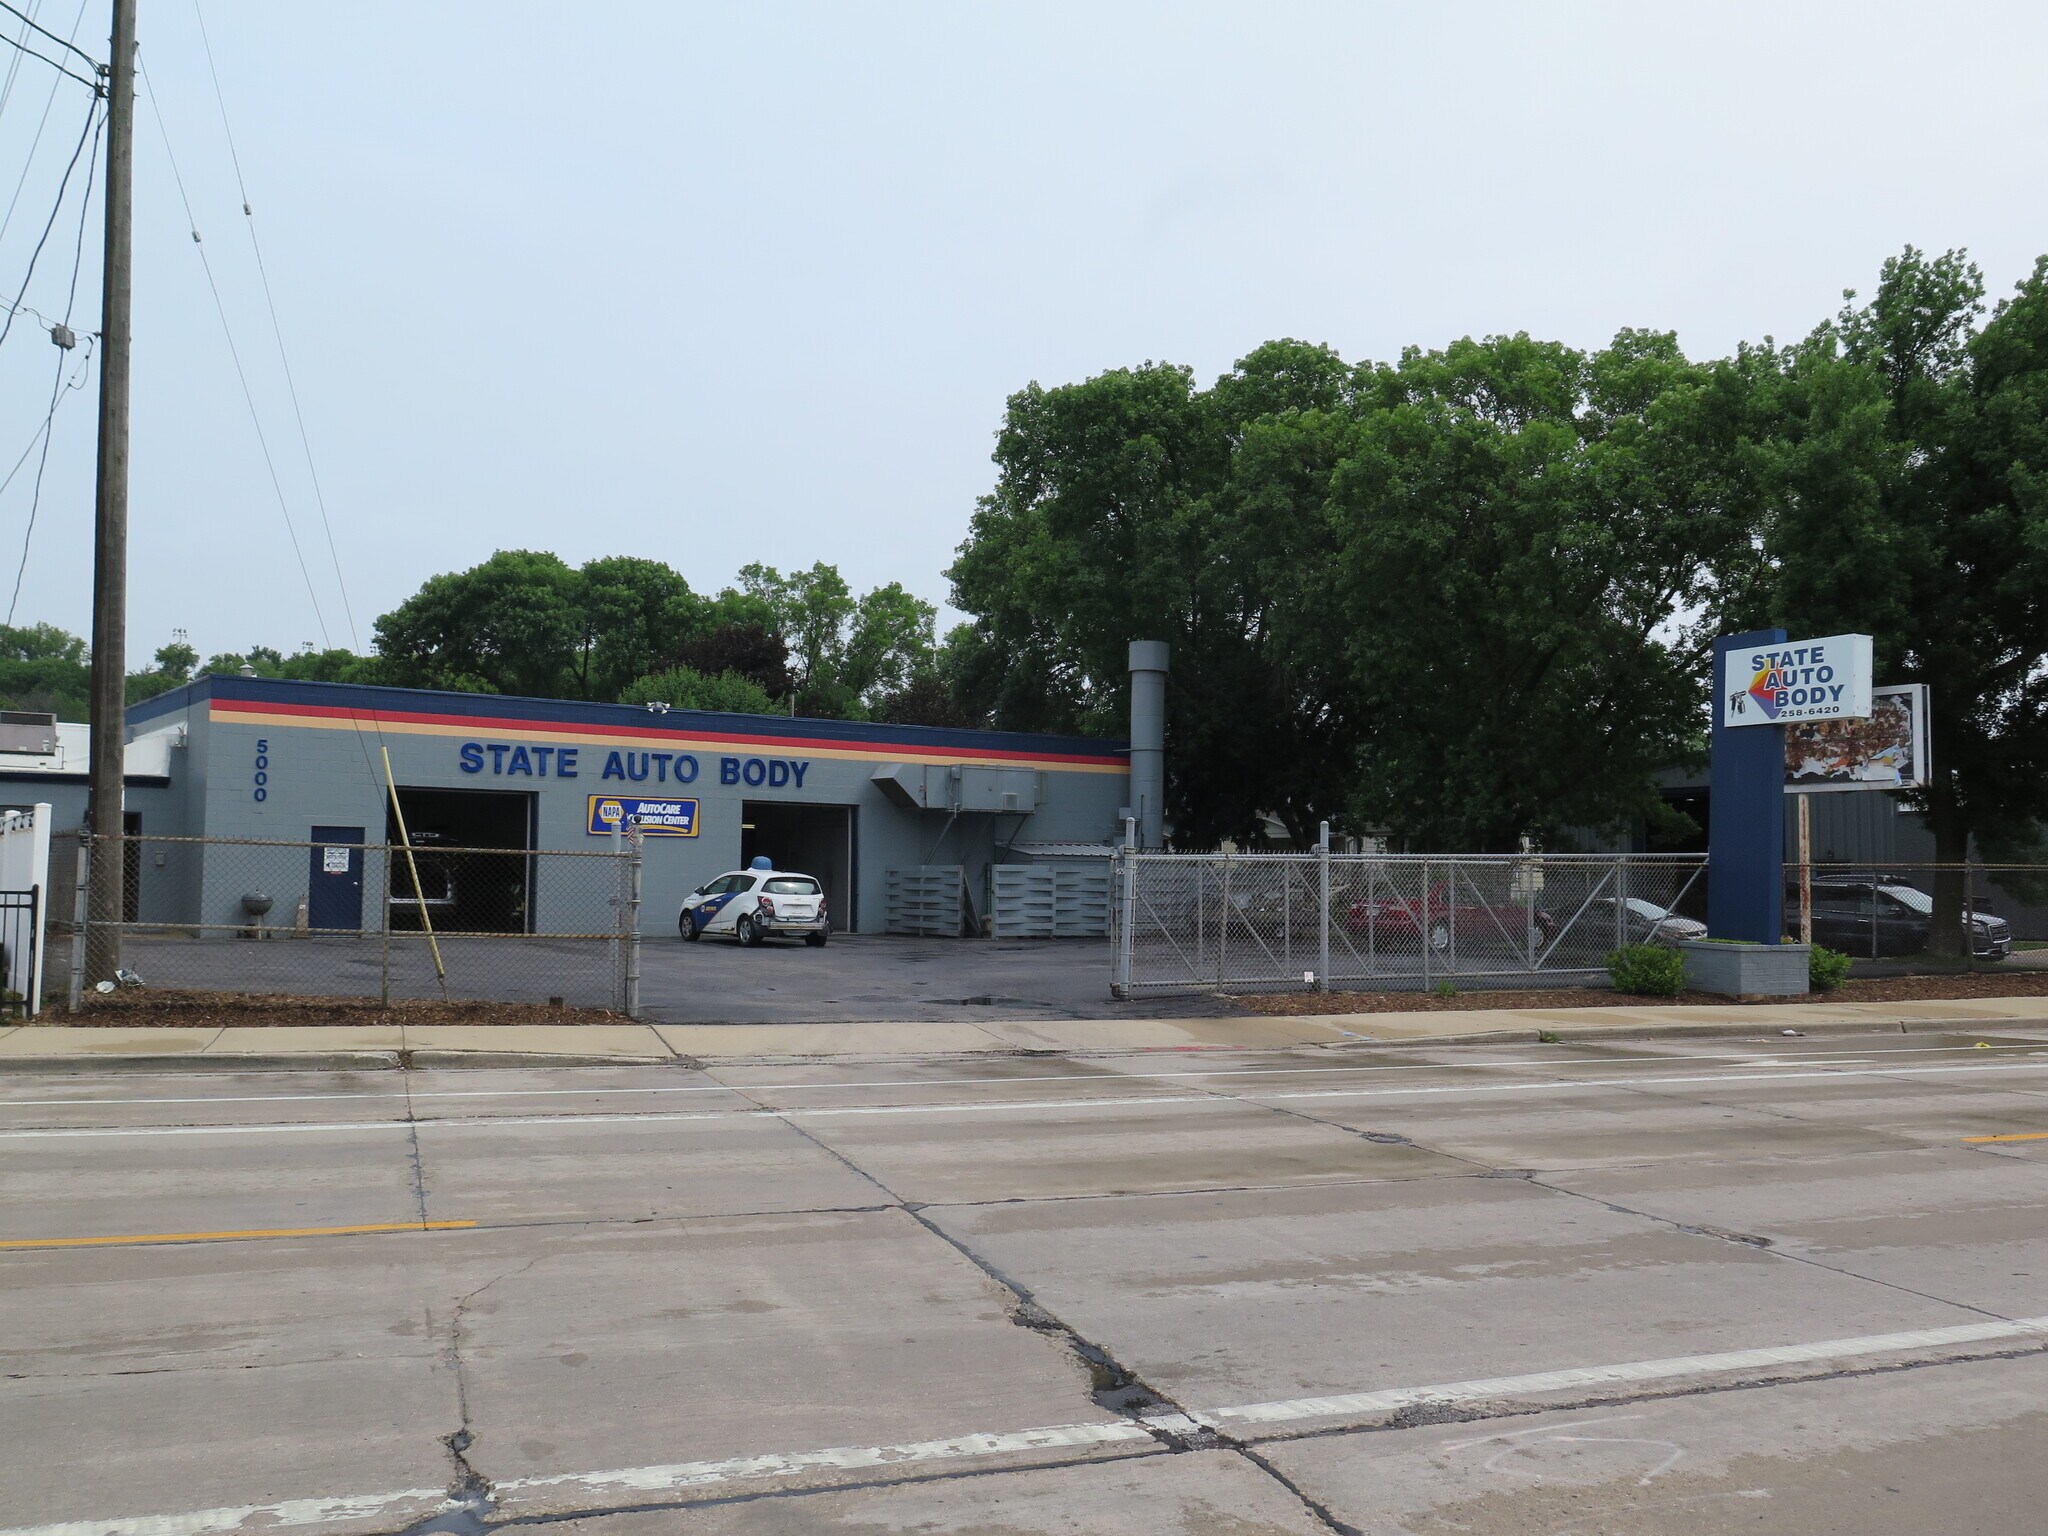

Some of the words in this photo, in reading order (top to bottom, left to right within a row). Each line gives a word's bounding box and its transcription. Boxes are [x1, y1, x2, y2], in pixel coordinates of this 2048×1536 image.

[1752, 645, 1825, 671] STATE
[1764, 666, 1834, 690] AUTO
[1774, 684, 1844, 708] BODY
[1780, 705, 1840, 718] 258-6420
[254, 739, 268, 802] 5000
[459, 743, 578, 778] STATE
[602, 751, 699, 783] AUTO
[720, 757, 810, 788] BODY
[602, 806, 620, 817] NAPA
[663, 815, 689, 825] CENTER
